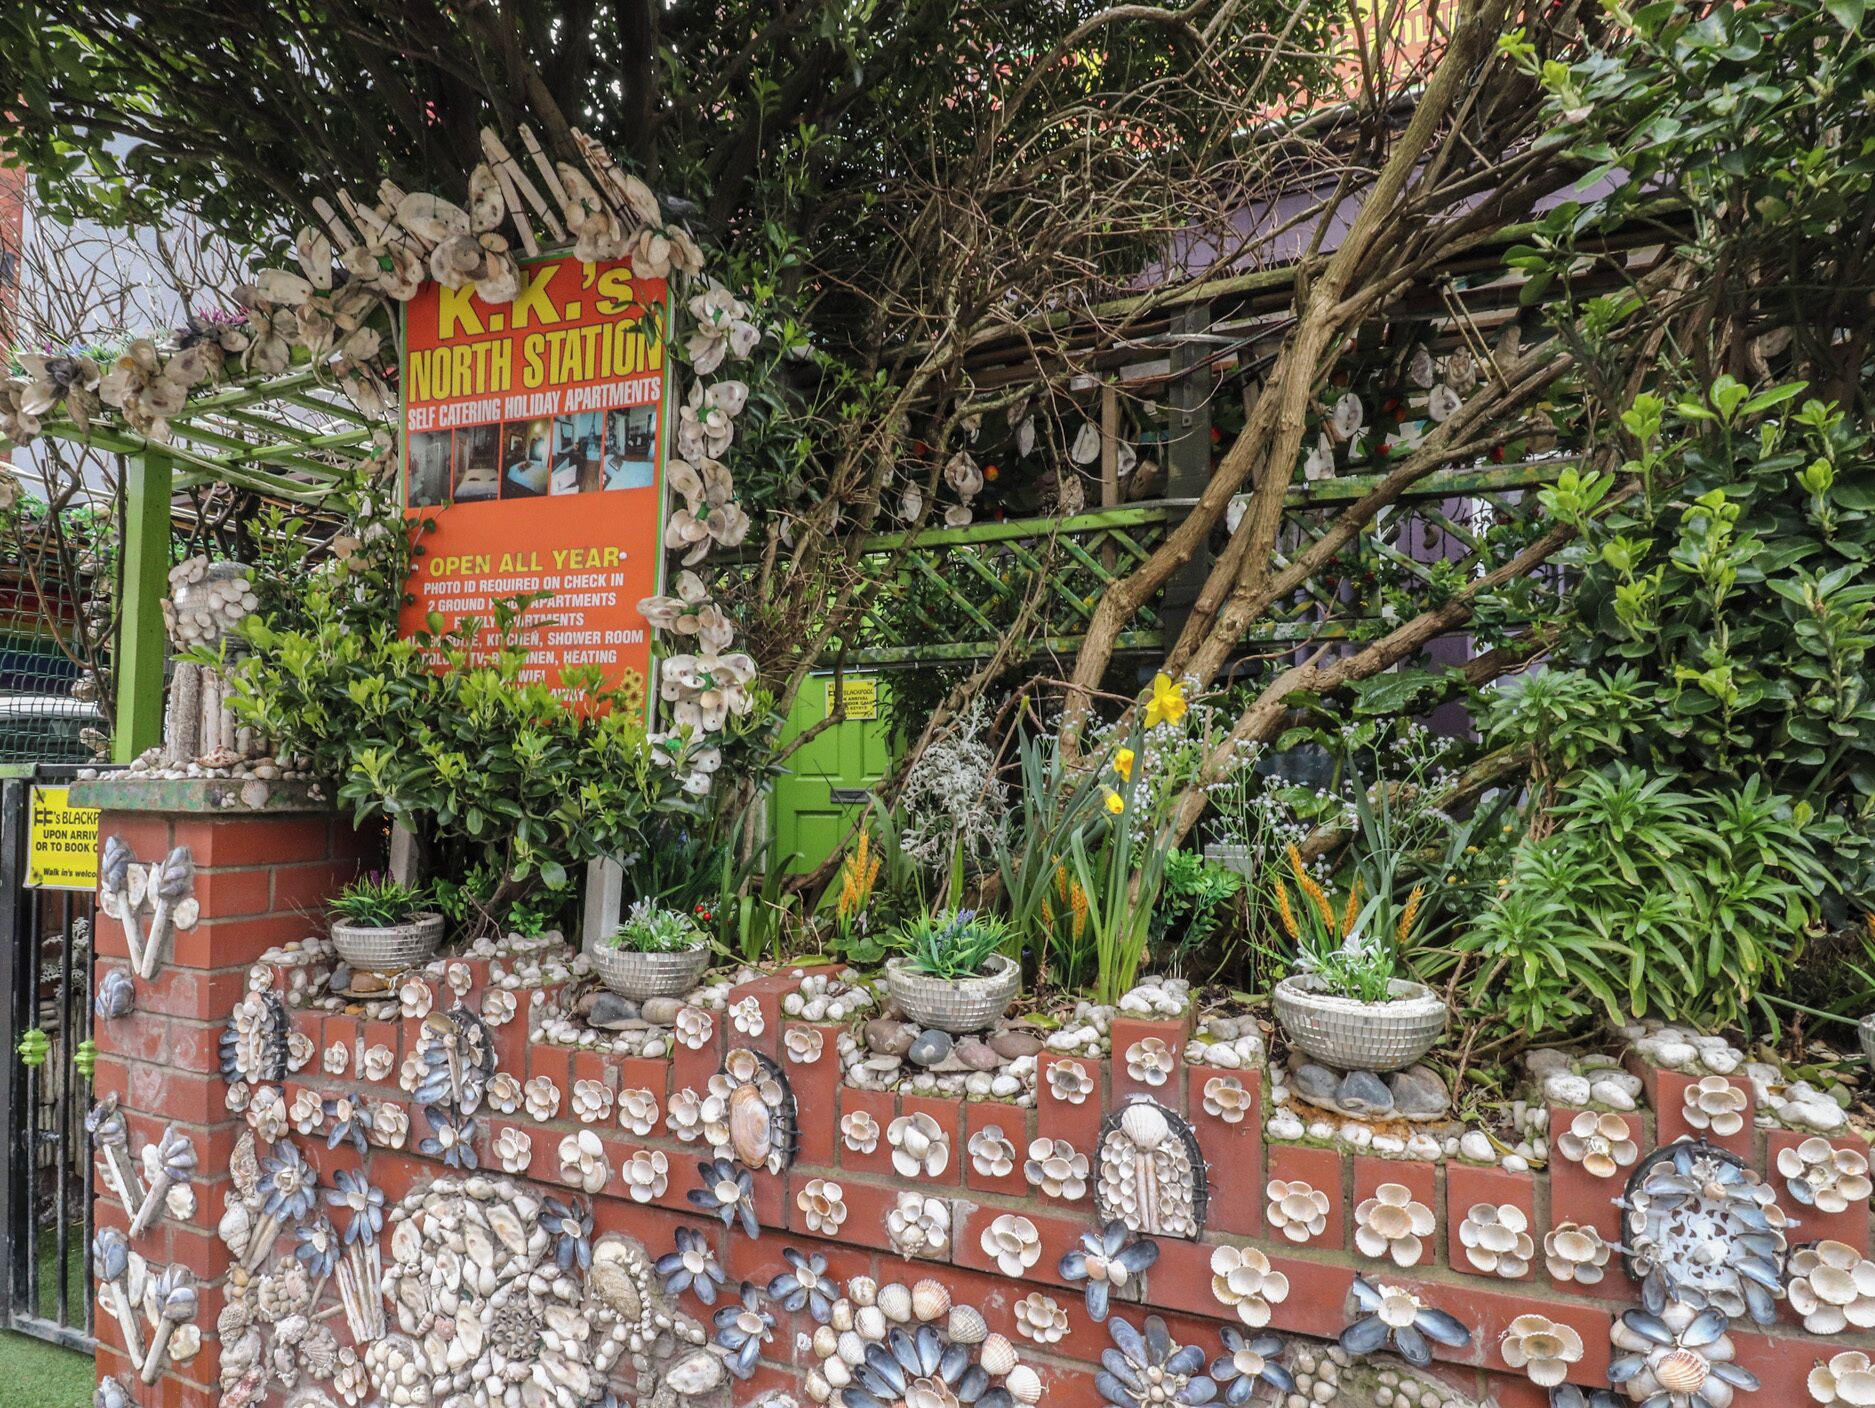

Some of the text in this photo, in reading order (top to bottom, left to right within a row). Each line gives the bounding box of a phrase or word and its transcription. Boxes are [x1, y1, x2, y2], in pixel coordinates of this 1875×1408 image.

[409, 313, 663, 403] NORTH STATION
[408, 376, 661, 431] SELF CATERING HOLIDAY APARTMENTS
[429, 546, 621, 577] OPEN ALL YEAR
[423, 572, 624, 595] PHOTO ID REQUIRED ON CHECK IN
[428, 600, 435, 612] 2
[438, 597, 484, 612] GROUND
[531, 592, 617, 608] APARTMENTS
[547, 631, 601, 645] SHOWER
[605, 629, 643, 644] ROOM
[563, 649, 617, 664] HEATING
[62, 811, 98, 825] BLACKP
[43, 830, 98, 840] UPON ARRIV
[35, 842, 48, 851] OR
[51, 842, 62, 852] TO
[64, 842, 90, 853] BOOK
[43, 868, 59, 876] Walk
[75, 870, 97, 878] welco
